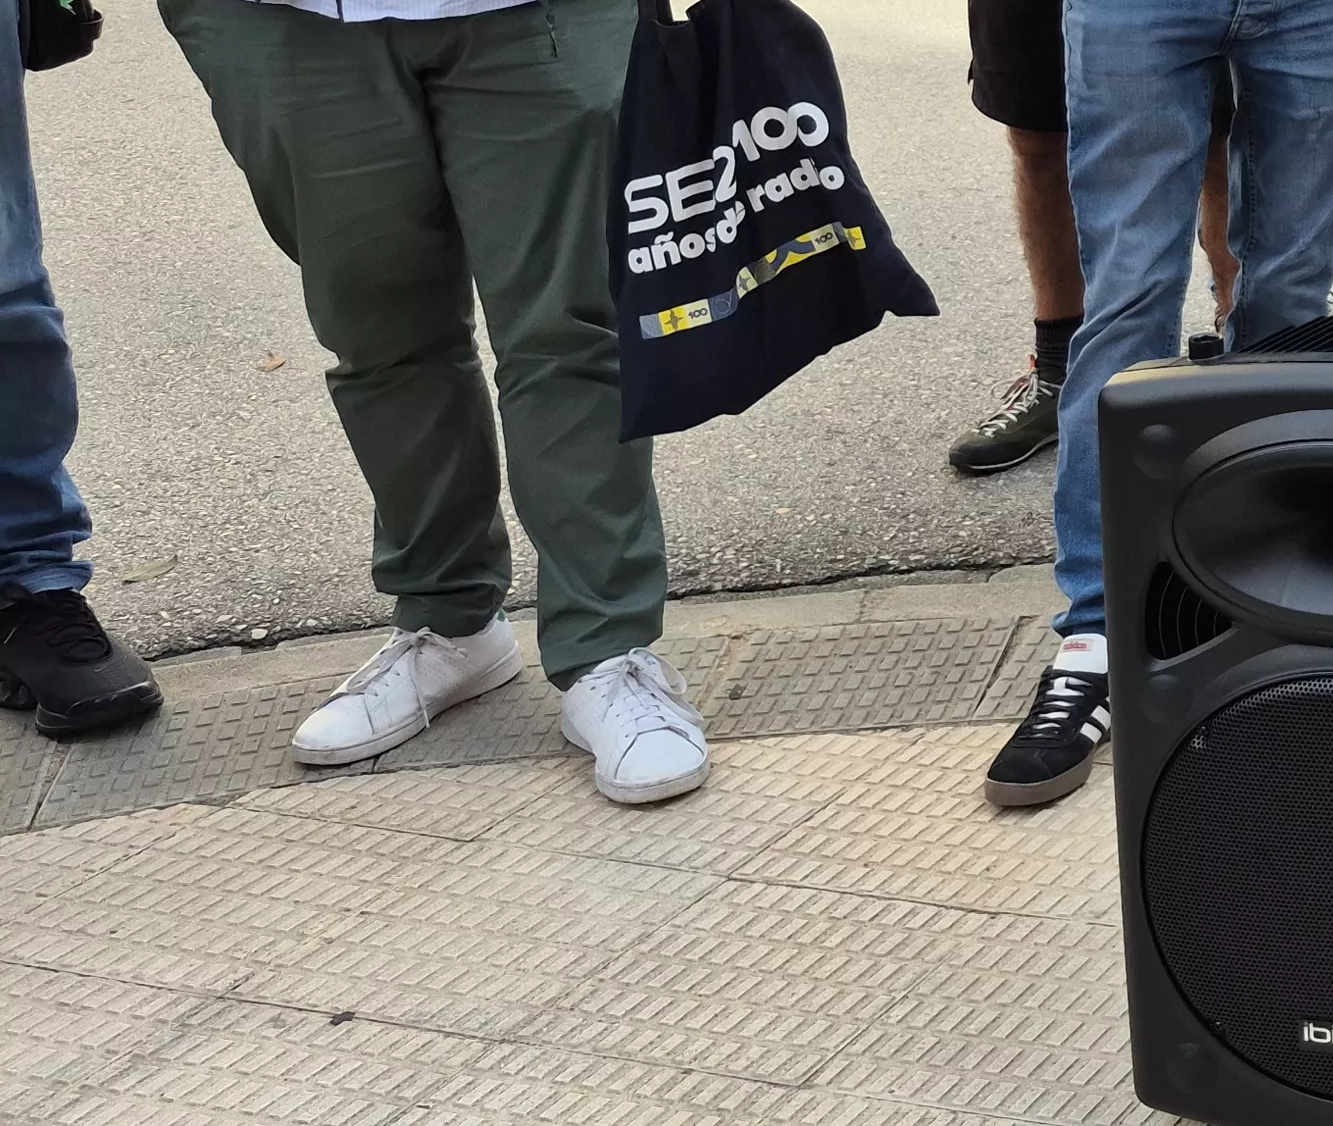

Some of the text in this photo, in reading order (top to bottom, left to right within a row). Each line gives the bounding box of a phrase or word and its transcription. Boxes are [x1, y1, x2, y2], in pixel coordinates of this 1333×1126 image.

[732, 101, 830, 162] 100
[813, 231, 833, 246] 100
[687, 307, 709, 320] 100
